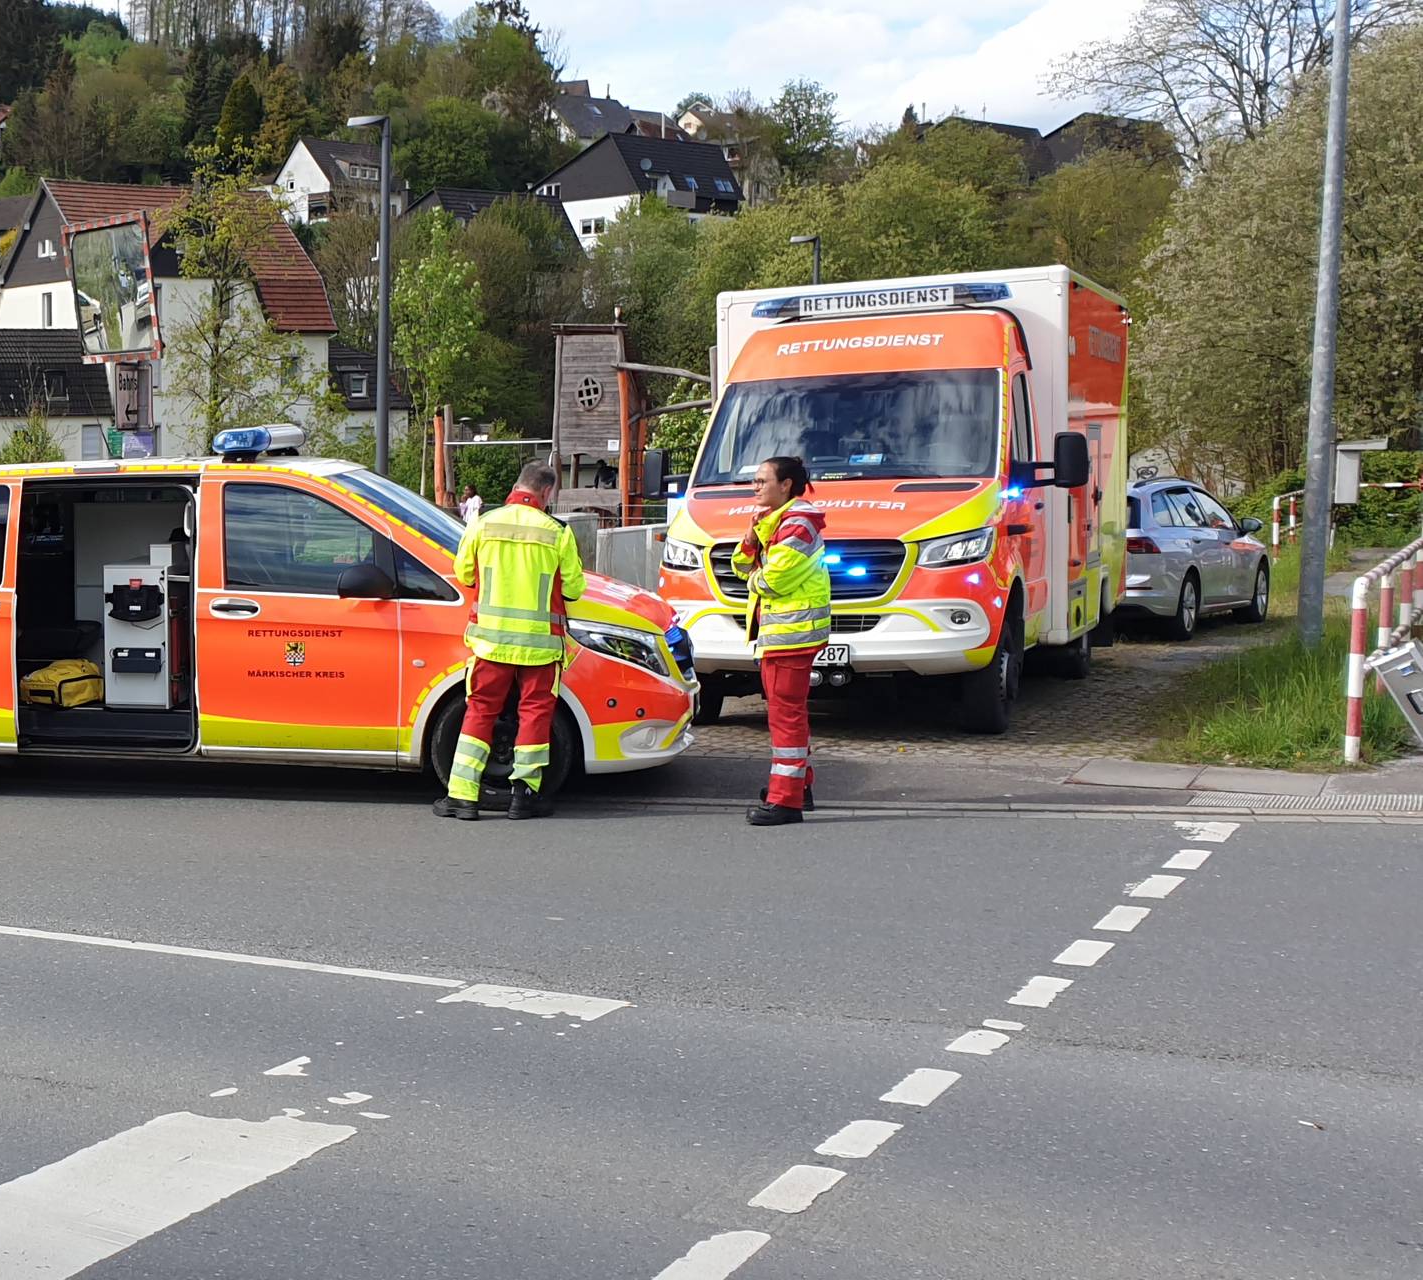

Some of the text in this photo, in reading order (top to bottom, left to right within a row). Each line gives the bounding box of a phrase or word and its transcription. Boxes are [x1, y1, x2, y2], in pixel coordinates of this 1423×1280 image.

[803, 288, 950, 313] RETTUNGSDIENST
[776, 333, 944, 357] RETTUNGSDIENST
[247, 629, 343, 638] RETTUNGSDIENST
[247, 669, 345, 679] MÄRKISCHER KREIS
